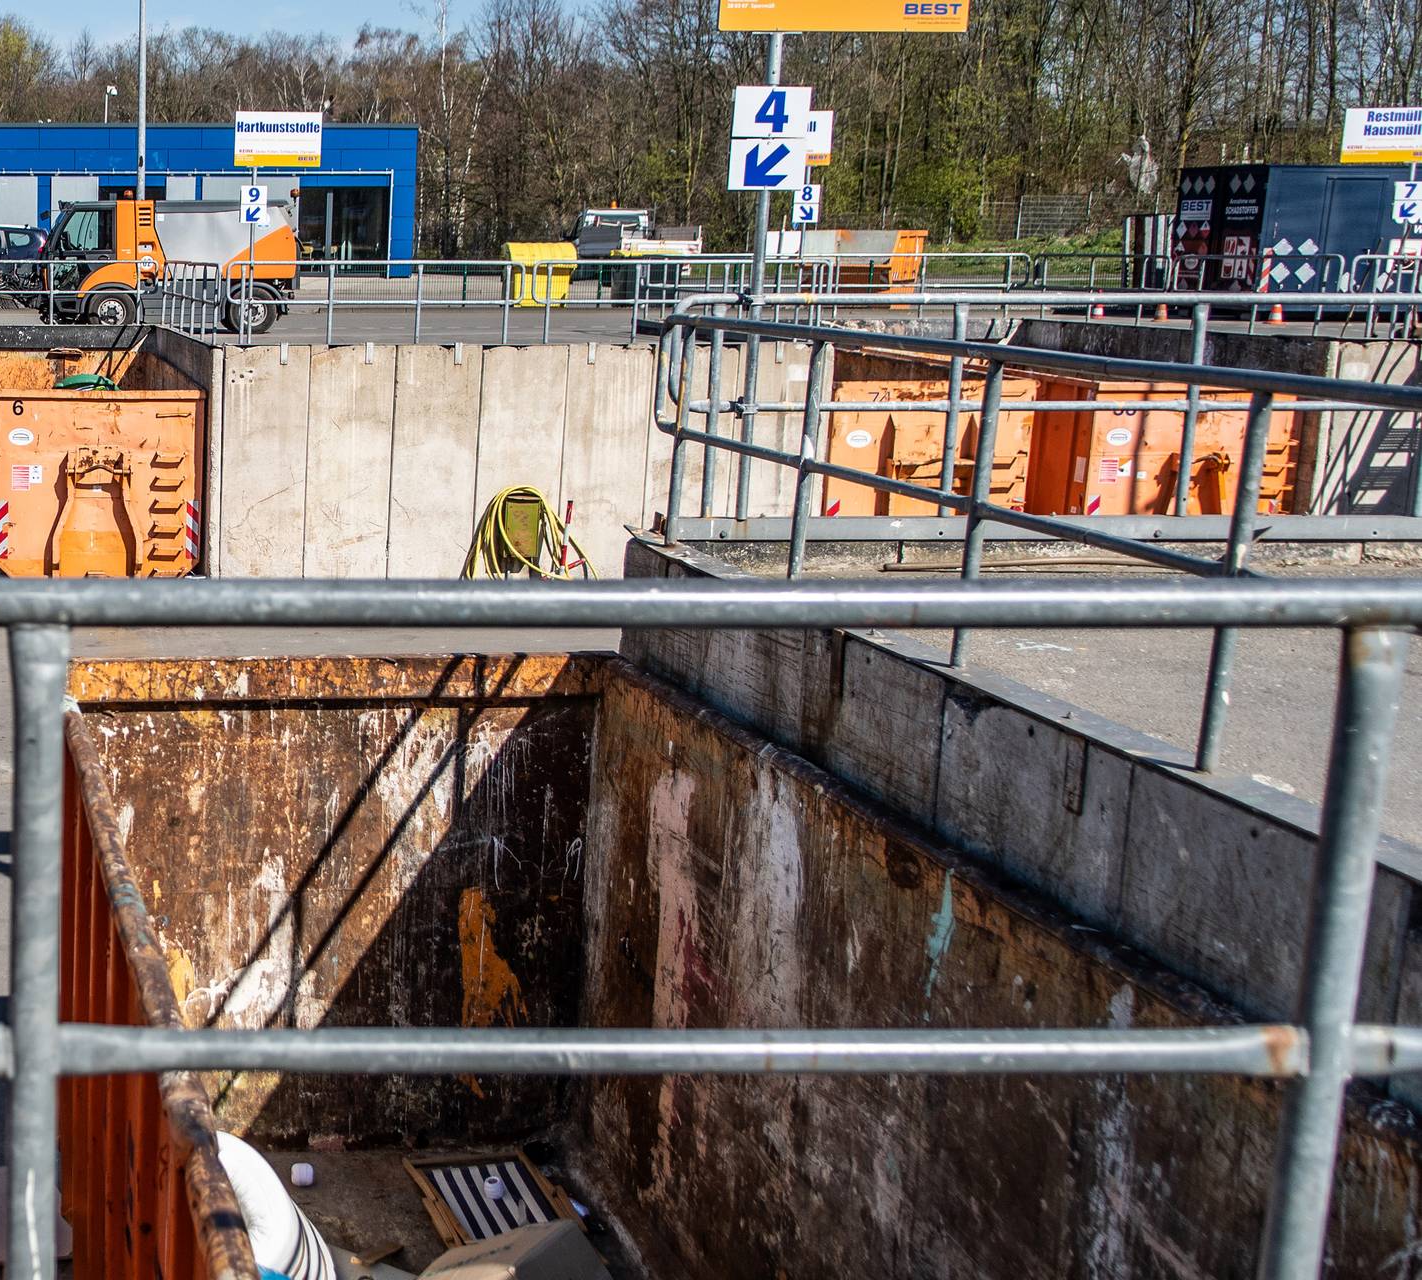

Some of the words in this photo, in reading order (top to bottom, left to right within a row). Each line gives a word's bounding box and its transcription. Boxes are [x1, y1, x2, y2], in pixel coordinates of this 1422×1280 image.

[904, 4, 962, 15] BEST
[755, 91, 789, 133] 4
[237, 121, 320, 133] Hartkunststoffe
[249, 187, 260, 202] 9
[801, 186, 813, 201] 8
[1405, 183, 1417, 198] 7
[1181, 201, 1211, 211] BEST
[13, 400, 24, 416] 6
